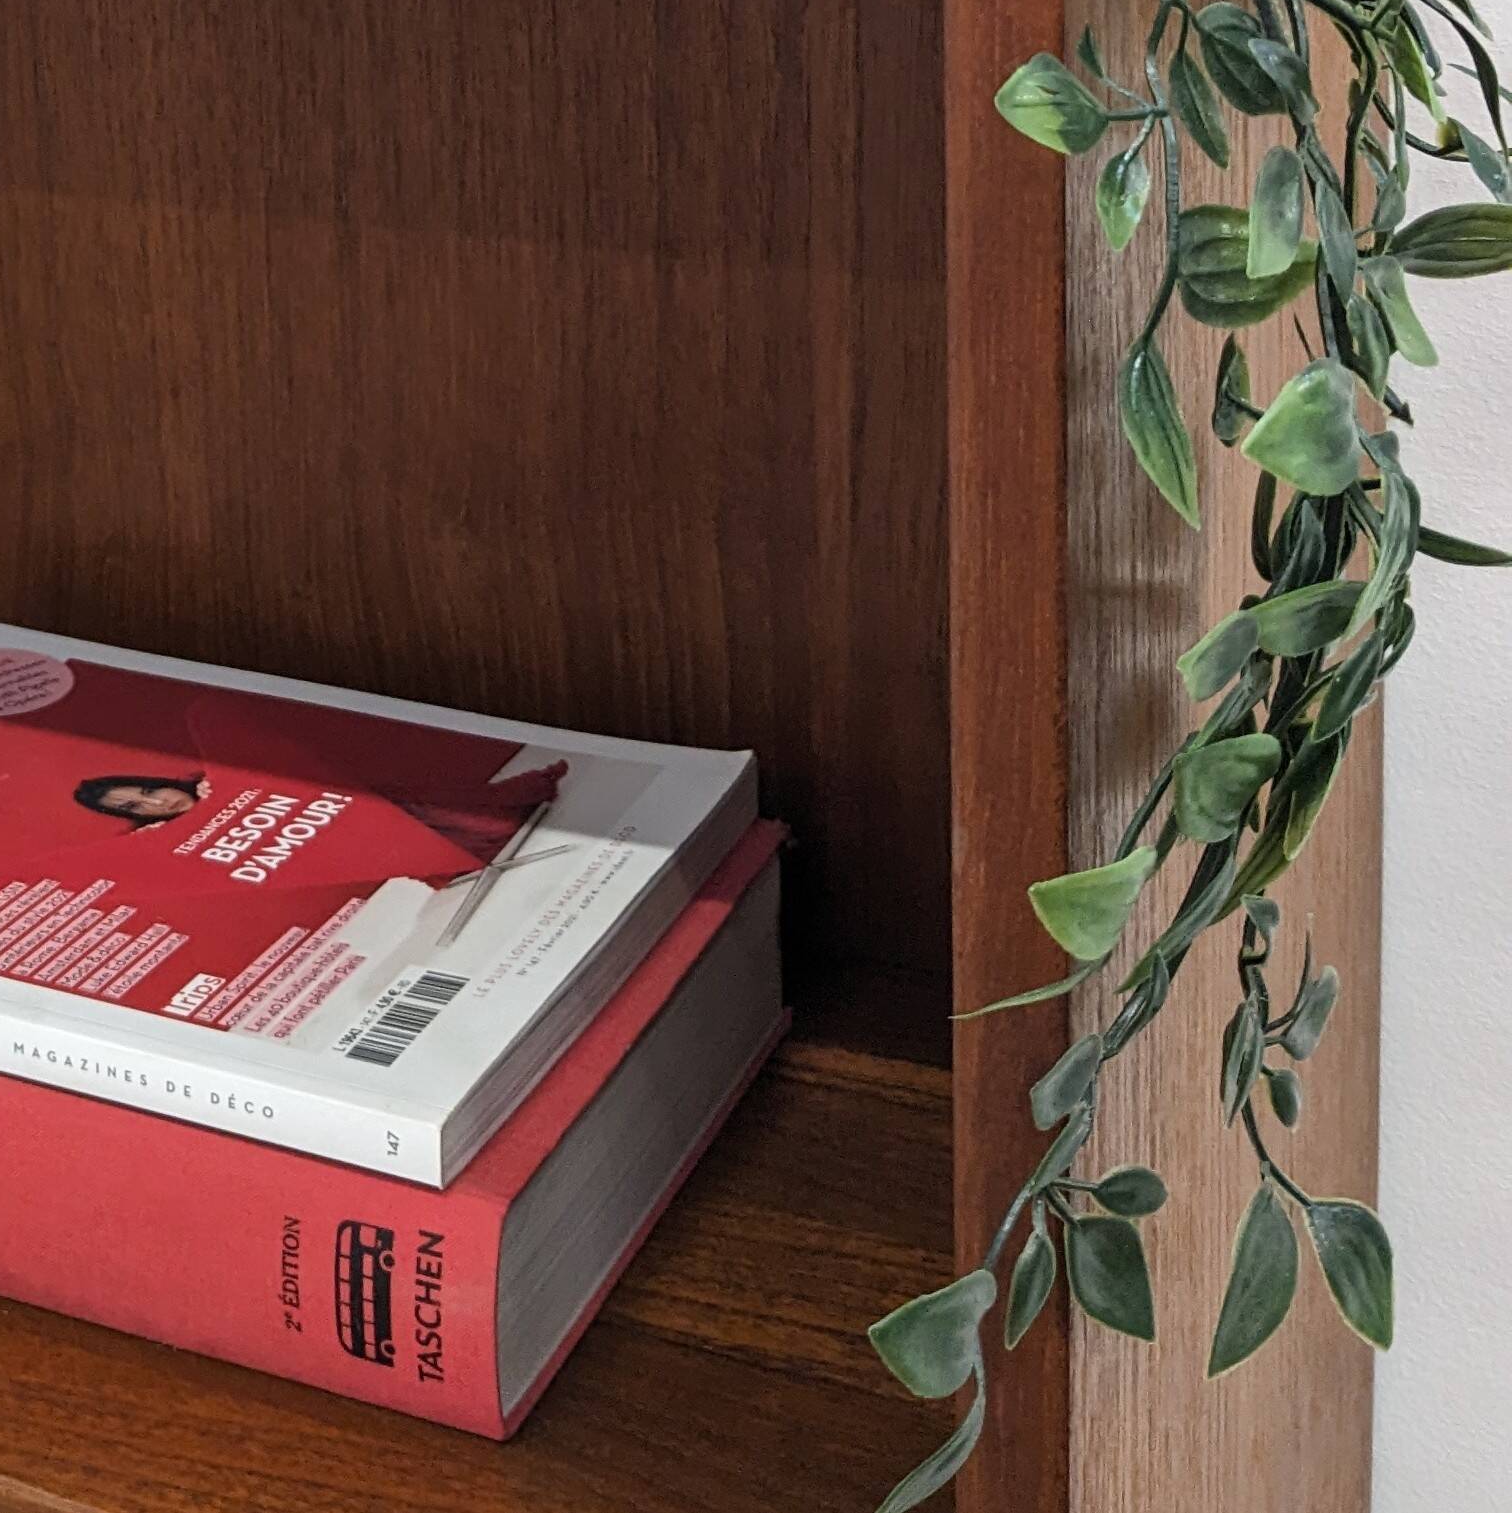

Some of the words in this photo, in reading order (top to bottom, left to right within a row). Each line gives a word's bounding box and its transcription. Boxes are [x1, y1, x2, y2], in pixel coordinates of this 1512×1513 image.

[173, 807, 236, 854] TENDANCES
[201, 794, 300, 863] BESOIN
[166, 974, 224, 1013] Trips
[197, 993, 234, 1019] Urban
[246, 1014, 274, 1033] Les
[14, 1042, 148, 1086] MAGAZINES
[166, 1080, 192, 1097] DE
[211, 1091, 274, 1119] DÉCO
[387, 1131, 400, 1156] 147
[278, 1215, 302, 1309] ÉDITION
[414, 1229, 445, 1384] TASCHEN
